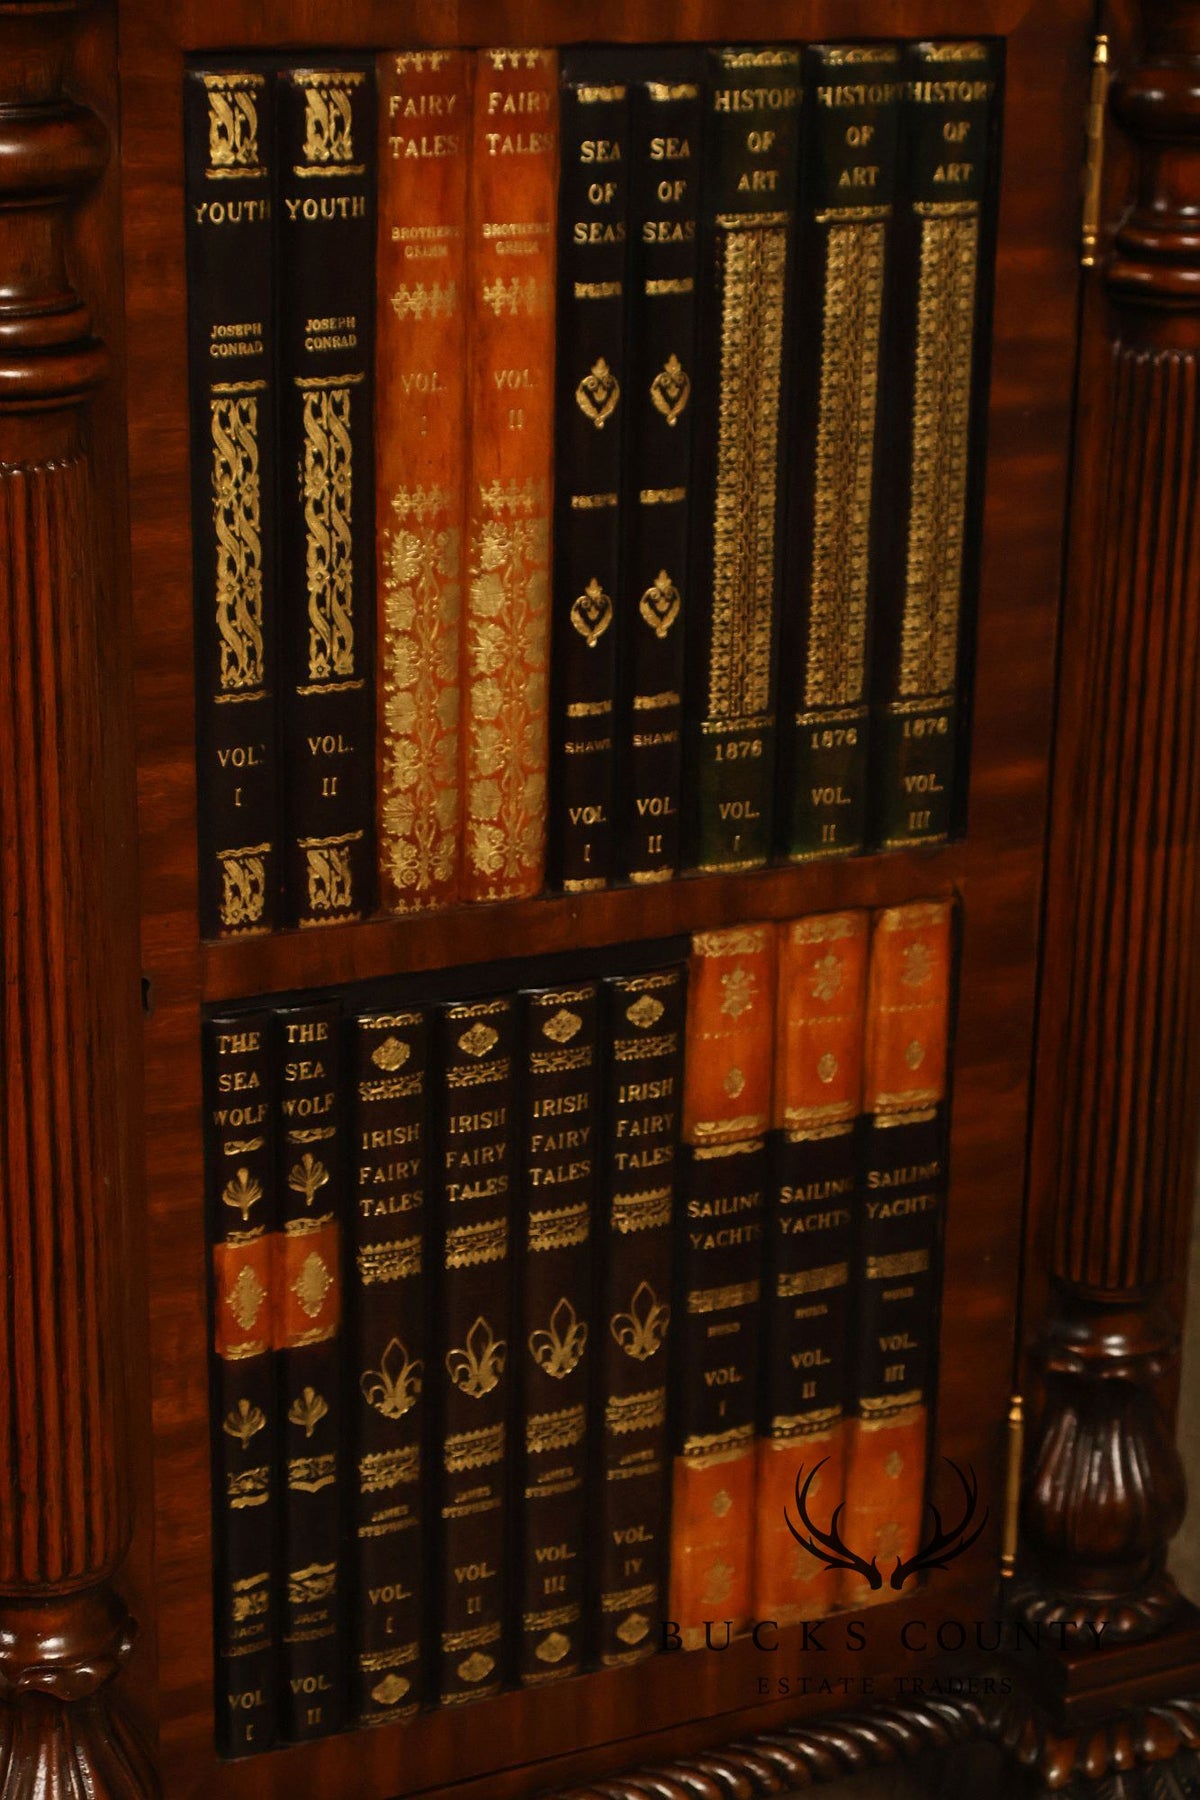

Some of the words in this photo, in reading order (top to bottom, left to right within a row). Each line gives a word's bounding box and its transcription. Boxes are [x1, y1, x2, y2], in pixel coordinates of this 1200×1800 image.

[389, 95, 456, 118] FAIRY
[487, 92, 551, 115] FAIRY
[747, 131, 775, 153] OF
[845, 125, 874, 147] OF
[943, 121, 970, 142] OF
[388, 136, 458, 159] TALES
[485, 133, 552, 156] TALES
[580, 140, 621, 164] SEA
[650, 137, 690, 161] SEA
[737, 170, 779, 192] ART
[837, 166, 879, 187] ART
[933, 163, 974, 183] ART
[587, 182, 617, 205] OF
[657, 179, 688, 203] OF
[194, 200, 271, 225] YOUTH
[285, 196, 366, 221] YOUTH
[573, 221, 626, 245] SEAS
[642, 220, 696, 244] SEAS
[210, 322, 261, 338] JOSEPH
[305, 316, 356, 333] JOSEPH
[210, 340, 263, 359] CONRAD
[304, 334, 357, 353] CONRAD
[714, 740, 762, 761] 1876
[234, 788, 242, 807] I
[322, 777, 337, 797] II
[718, 801, 760, 819] VOL.
[908, 810, 931, 830] III
[647, 833, 662, 854] II
[733, 834, 740, 852] I
[821, 824, 836, 842] II
[584, 844, 591, 862] I
[217, 1031, 260, 1054] THE
[285, 1022, 328, 1043] THE
[219, 1071, 260, 1092] SEA
[284, 1060, 326, 1081] SEA
[617, 1078, 674, 1103] IRISH
[213, 1104, 268, 1126] WOLF
[282, 1092, 335, 1117] WOLF
[533, 1093, 589, 1118] IRISH
[449, 1107, 506, 1134] IRISH
[615, 1113, 675, 1138] FAIRY
[361, 1123, 420, 1150] IRISH
[530, 1127, 591, 1153] FAIRY
[445, 1142, 506, 1168] FAIRY
[614, 1145, 674, 1171] TALES
[359, 1159, 421, 1184] FAIRY
[528, 1160, 591, 1186] TALES
[445, 1175, 509, 1202] TALES
[359, 1190, 424, 1217] TALES
[884, 1363, 905, 1382] III
[803, 1381, 817, 1399] II
[719, 1400, 727, 1417] I
[623, 1558, 643, 1577] IV
[543, 1575, 566, 1595] III
[466, 1596, 480, 1614] II
[385, 1616, 394, 1634] I
[307, 1708, 322, 1726] II
[246, 1724, 254, 1741] I
